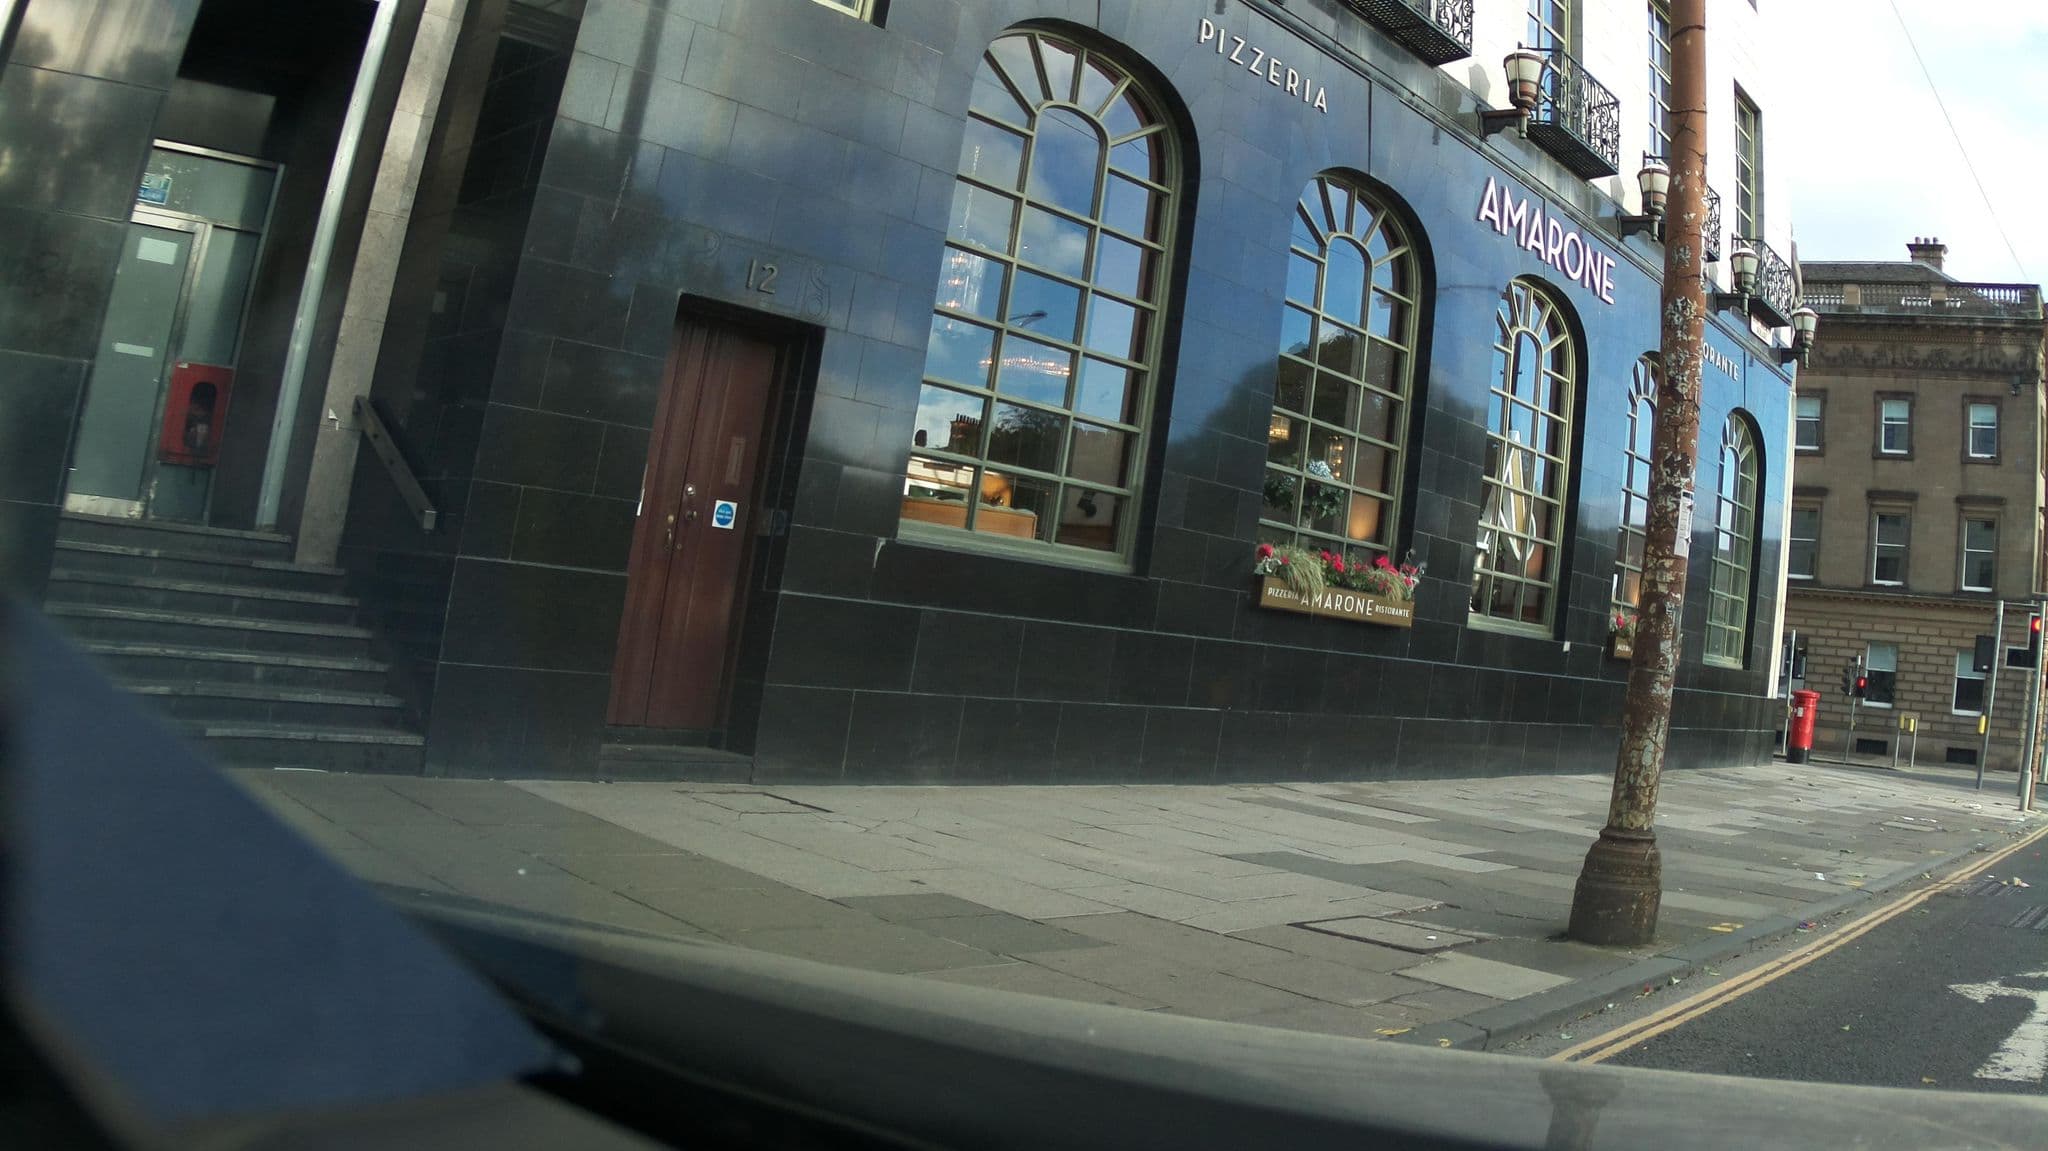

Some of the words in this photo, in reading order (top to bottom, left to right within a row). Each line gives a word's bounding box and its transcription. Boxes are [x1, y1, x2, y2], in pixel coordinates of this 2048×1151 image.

[1198, 18, 1328, 114] PIZZERIA
[1477, 175, 1616, 305] AMARONE
[745, 259, 778, 295] 12
[1702, 342, 1739, 381] ORANTE
[1267, 586, 1299, 601] PIZZERIA
[1300, 591, 1374, 616] AMARONE
[1375, 604, 1410, 618] RISTORANTE
